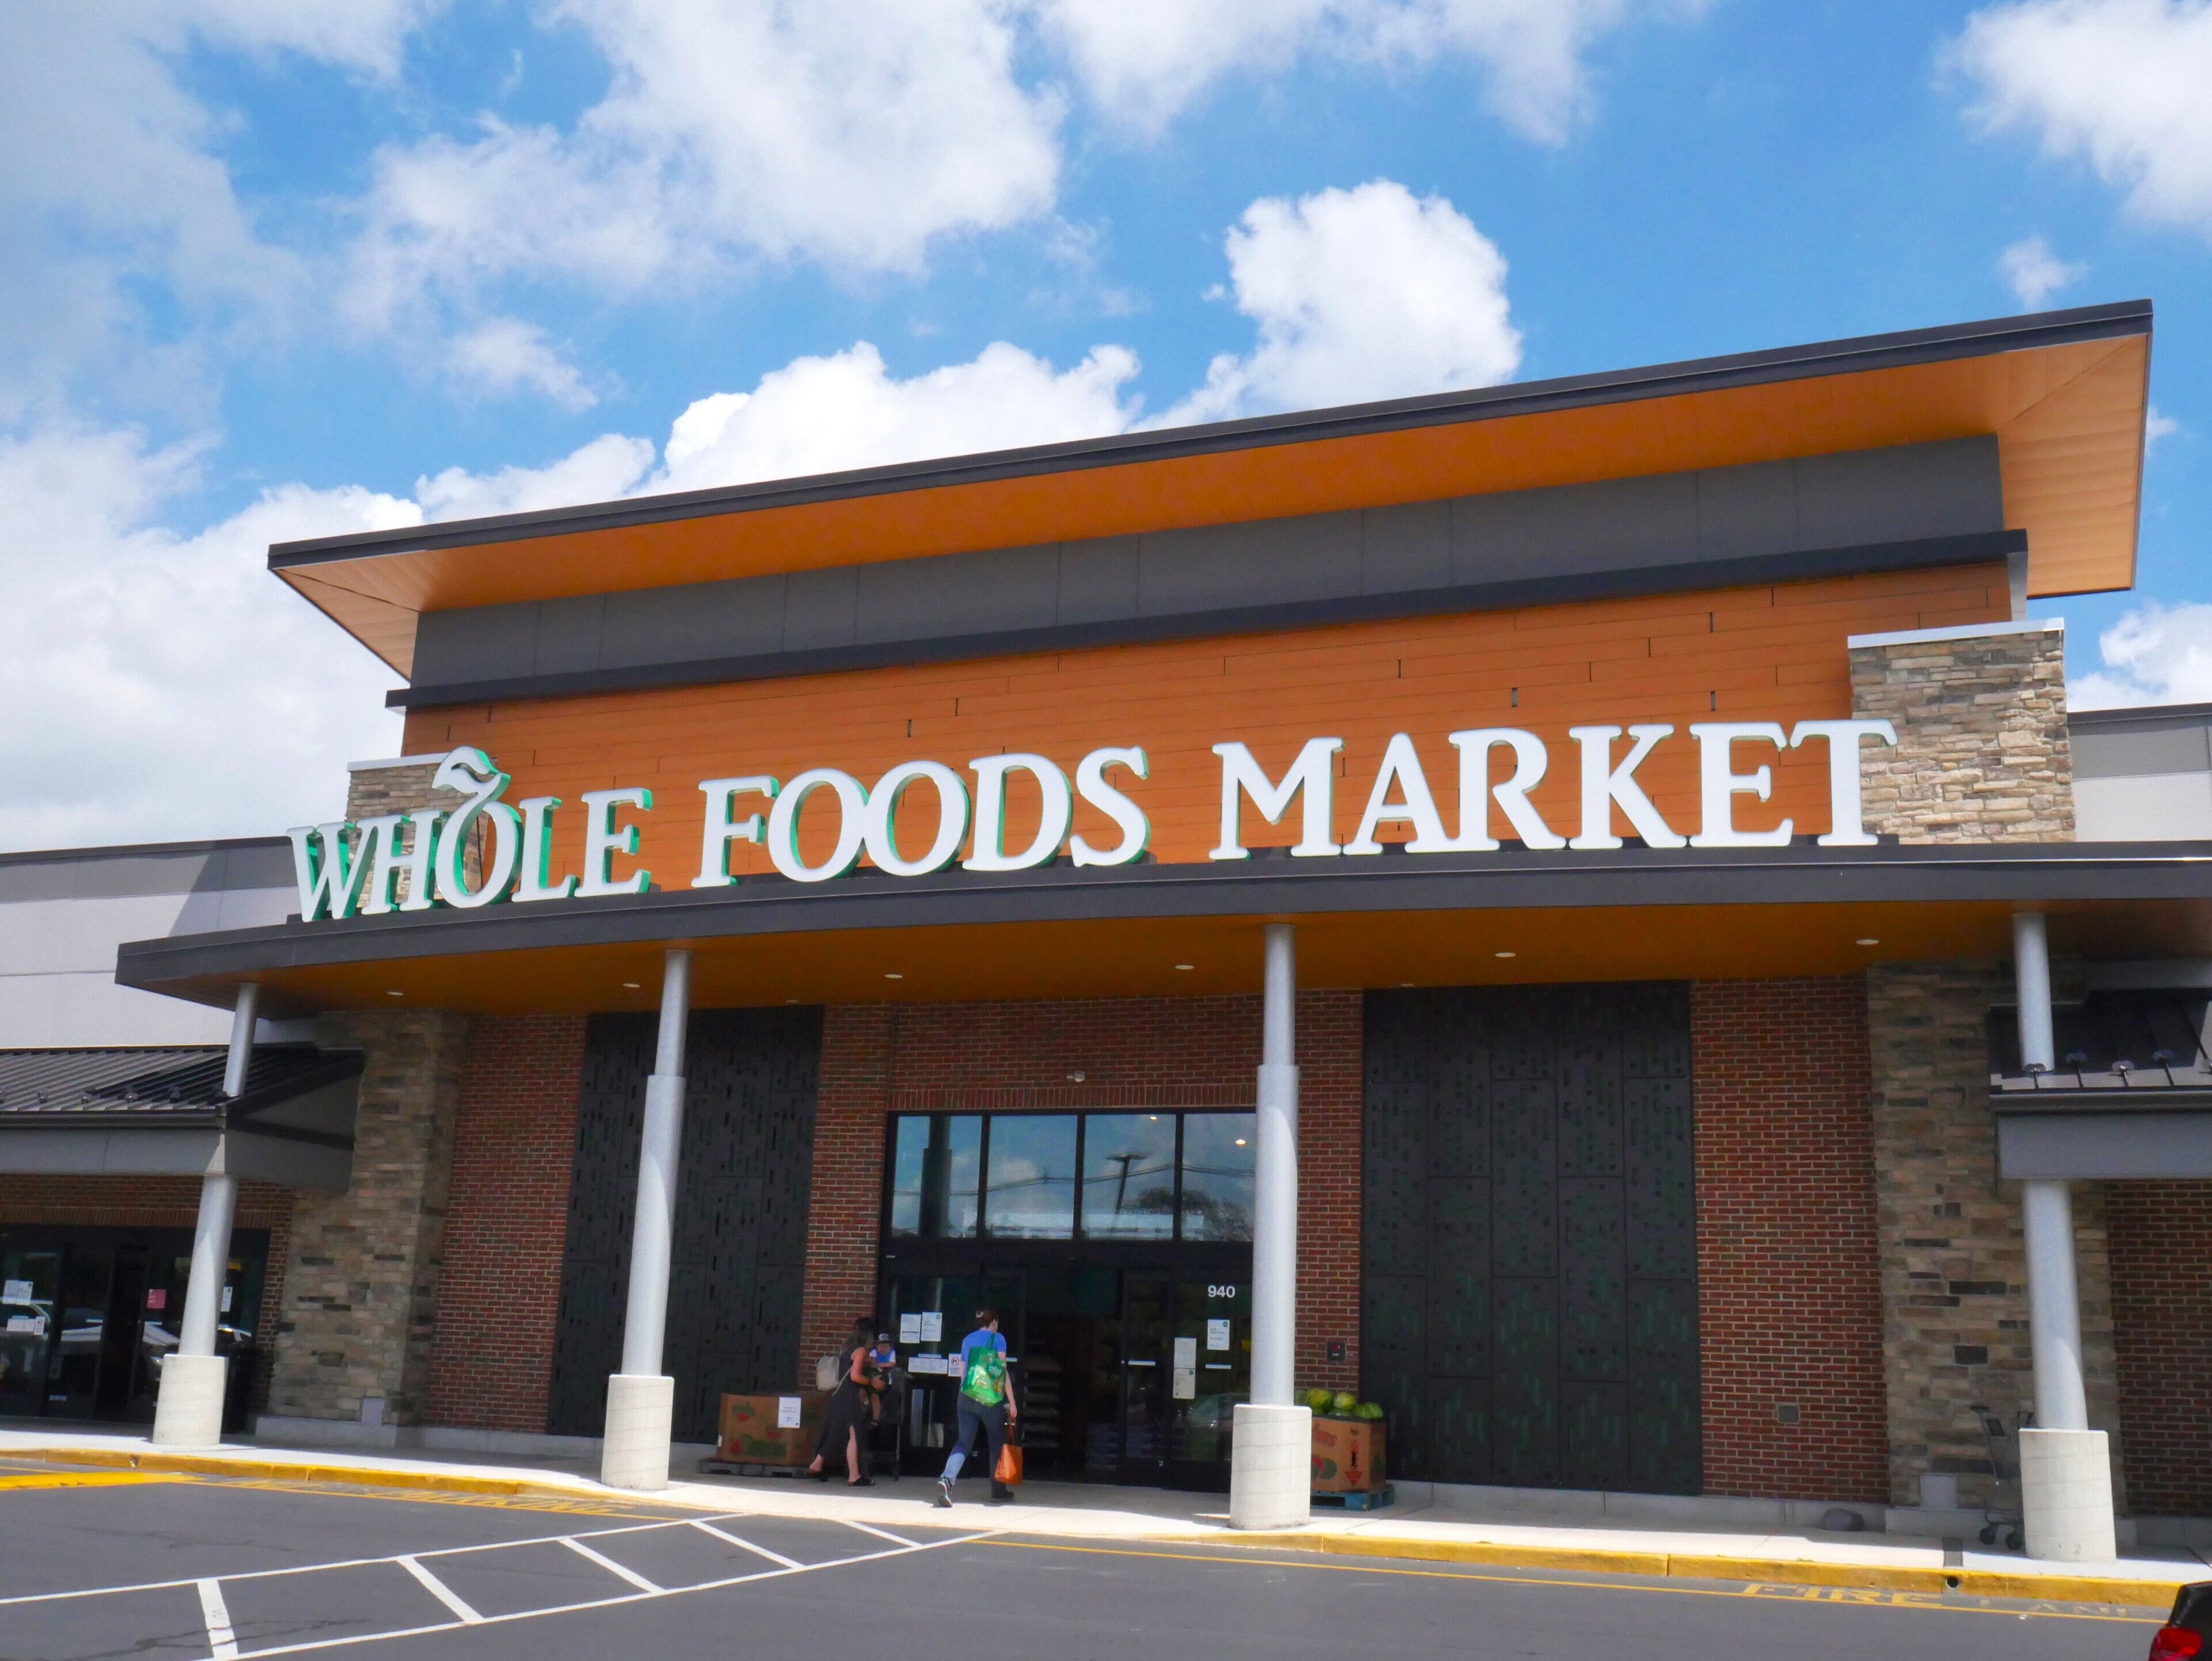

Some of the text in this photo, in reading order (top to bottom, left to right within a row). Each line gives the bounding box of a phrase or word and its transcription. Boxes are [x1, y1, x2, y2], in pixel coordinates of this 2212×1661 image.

[286, 718, 1898, 922] WHOLE FOODS MARKET
[1207, 1284, 1236, 1298] 940
[1741, 1583, 1943, 1607] FIRE
